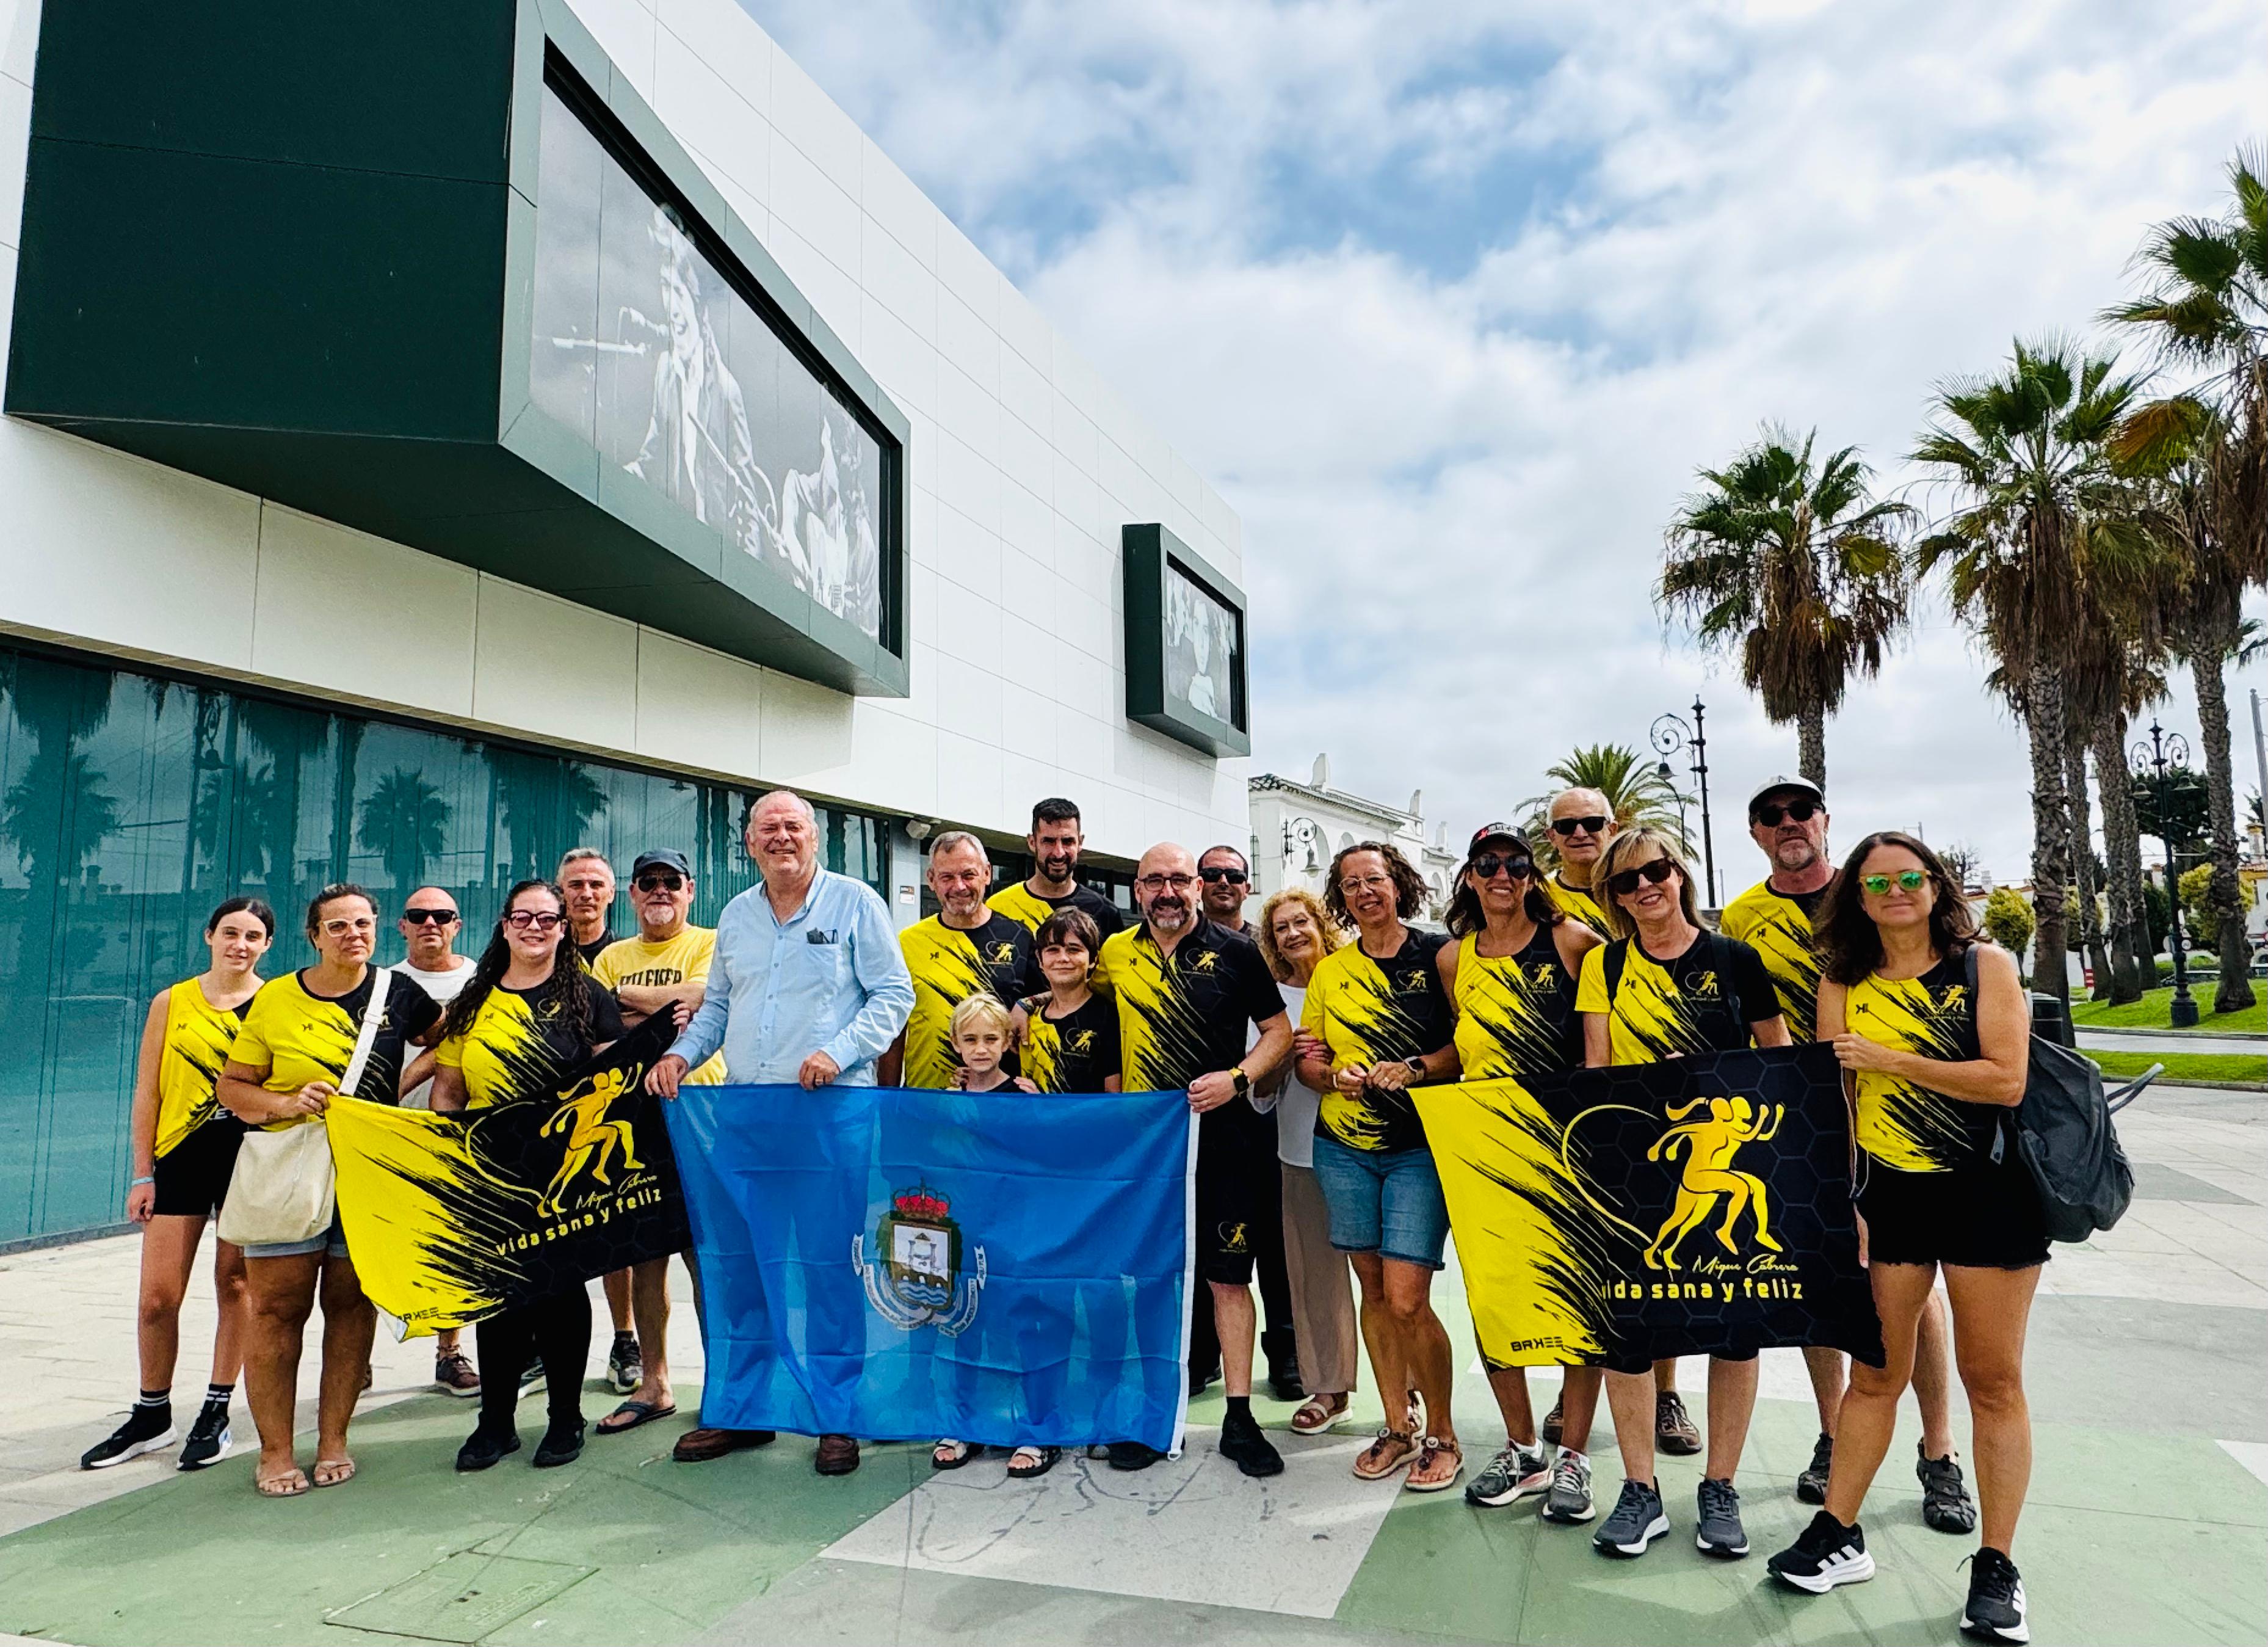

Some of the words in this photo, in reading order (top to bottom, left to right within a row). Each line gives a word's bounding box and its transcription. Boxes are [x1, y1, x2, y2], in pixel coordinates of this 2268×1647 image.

[496, 1232, 540, 1256] vida
[545, 1214, 594, 1241] sana
[600, 1207, 609, 1224] y
[615, 1187, 661, 1213] feliz
[1651, 1283, 1712, 1299] sana
[1721, 1282, 1734, 1303] y
[1743, 1278, 1803, 1300] feliz
